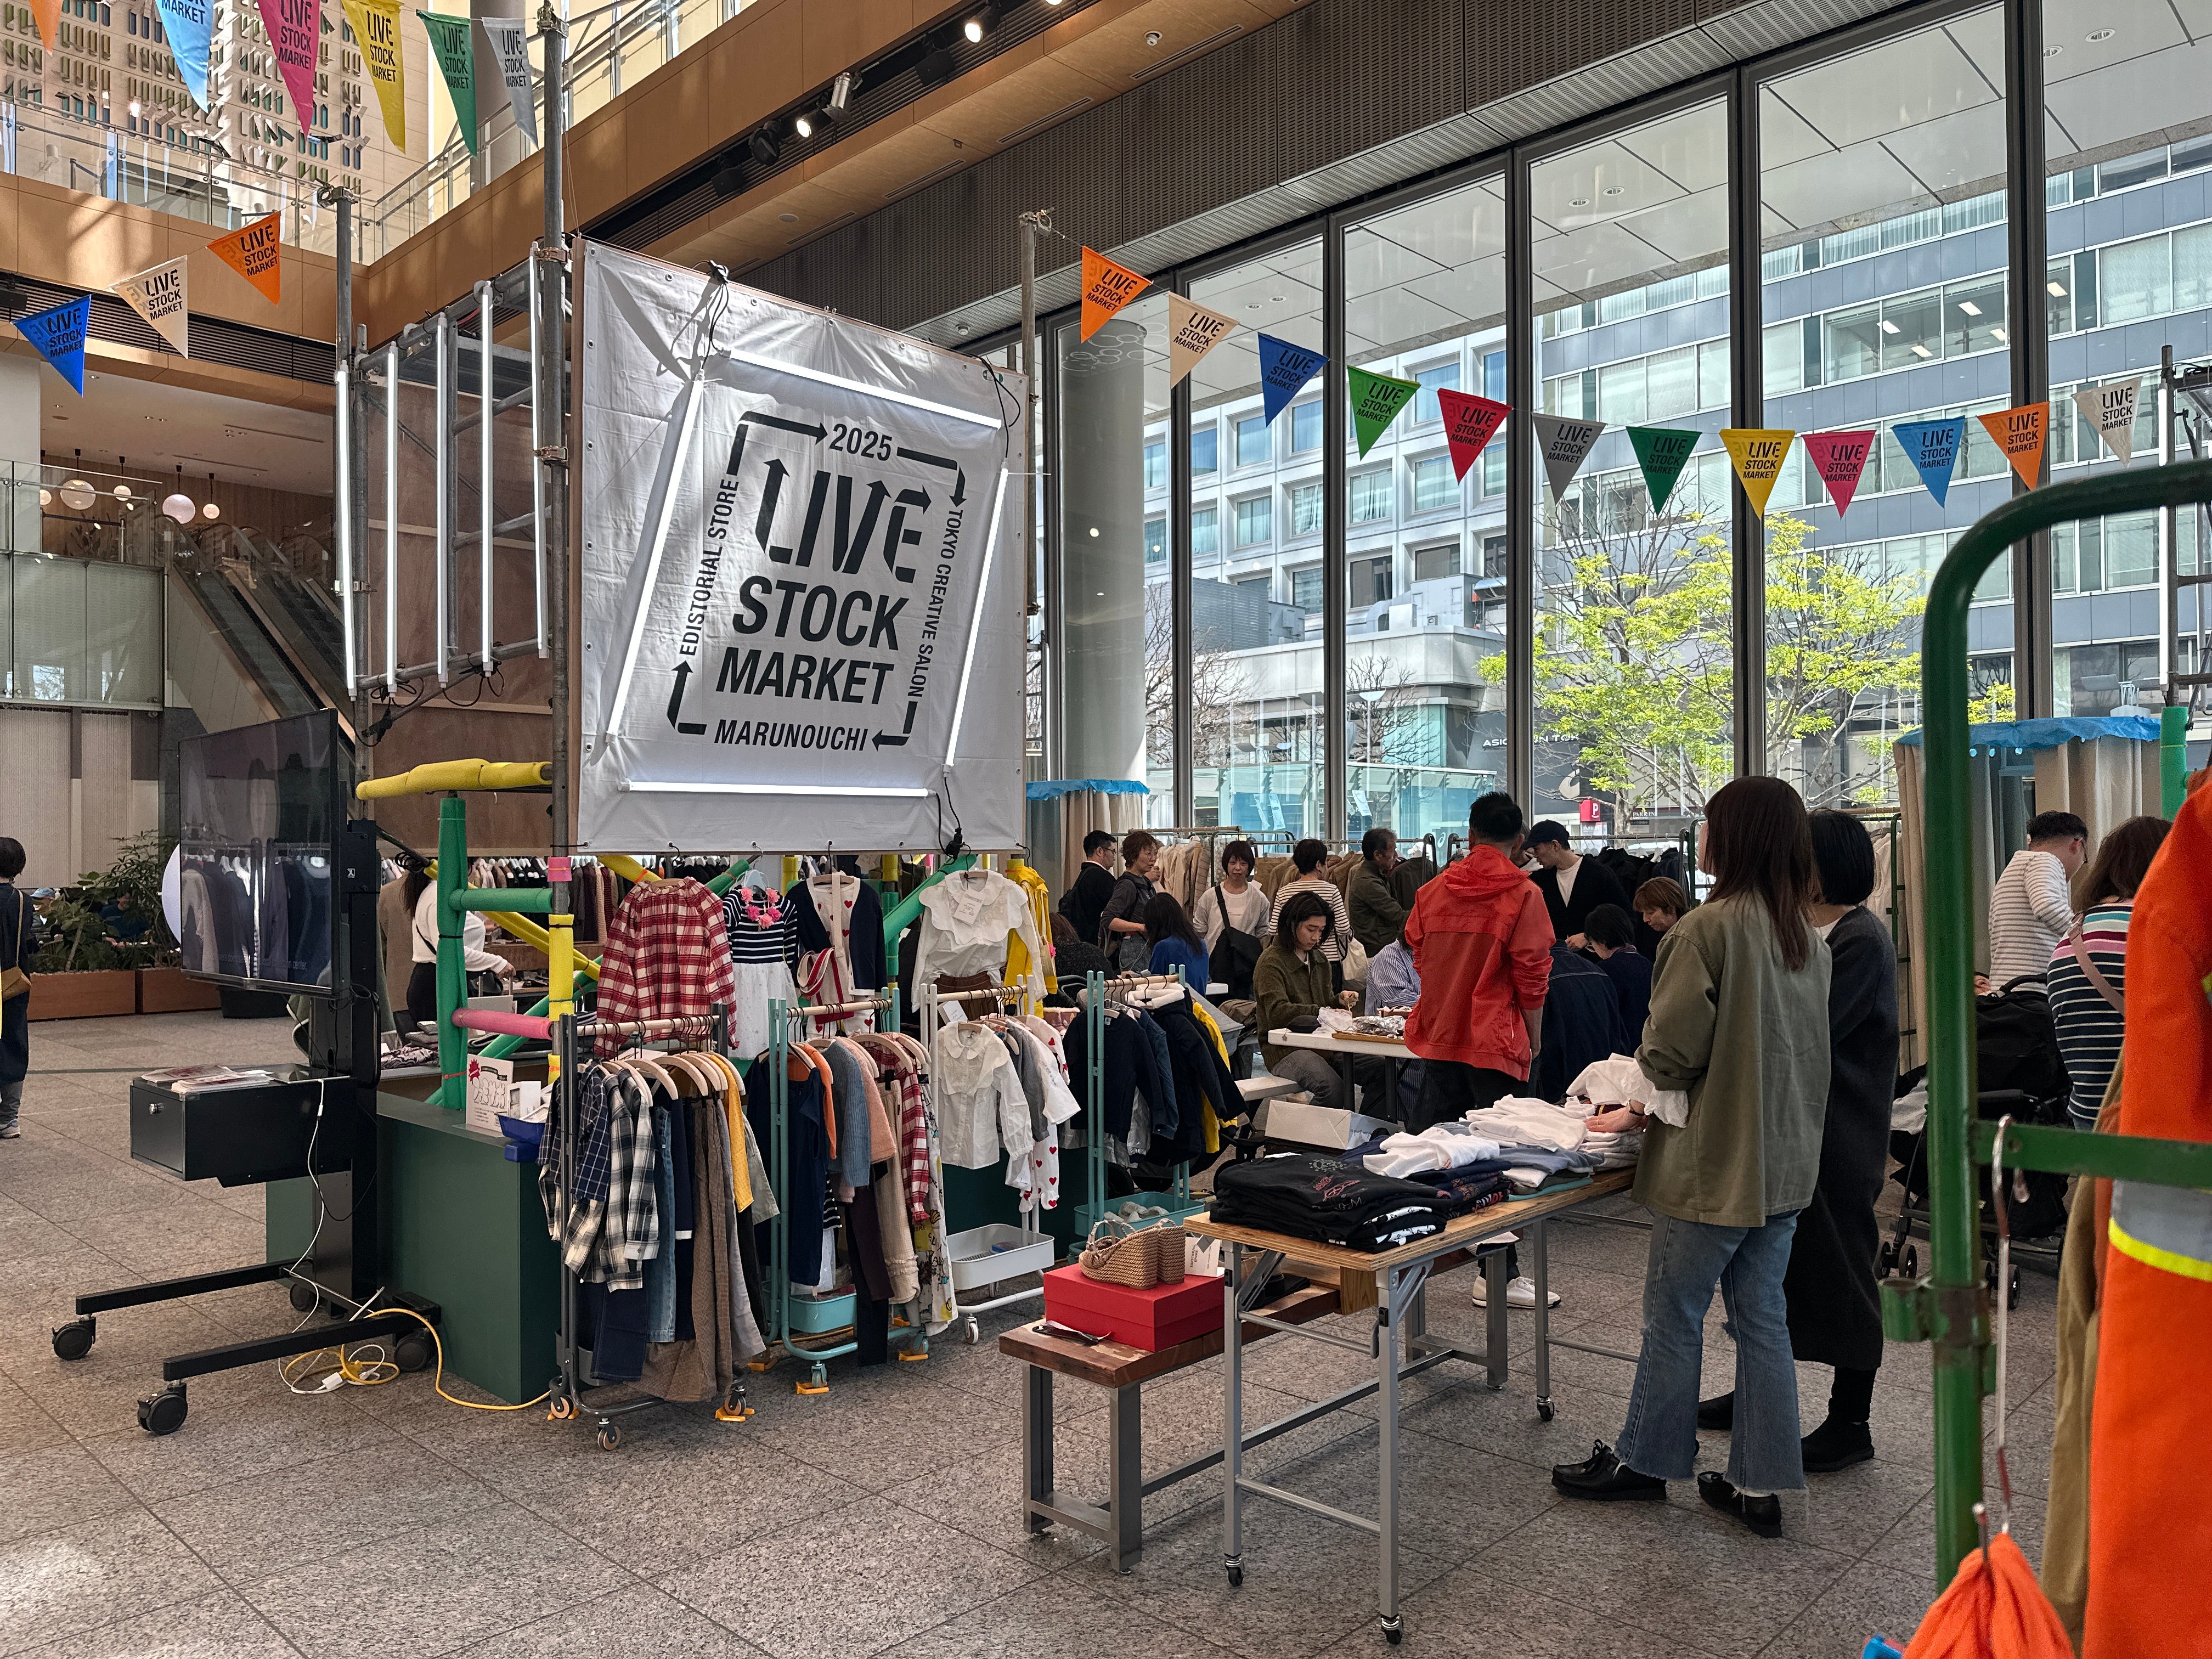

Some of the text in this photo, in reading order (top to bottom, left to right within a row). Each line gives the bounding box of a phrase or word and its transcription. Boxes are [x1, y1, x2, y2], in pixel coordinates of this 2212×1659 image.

[162, 0, 205, 25] MARKET
[281, 0, 312, 32] LIVE
[366, 10, 393, 47] LIVE
[281, 26, 311, 53] STOCK
[442, 25, 466, 55] LIVE
[501, 29, 522, 55] LIVE
[279, 48, 311, 70] MARKET
[370, 45, 396, 66] STOCK
[371, 63, 396, 82] MARKET
[445, 57, 468, 74] STOCK
[505, 58, 524, 73] STOCK
[445, 74, 469, 89] MARKET
[506, 76, 526, 87] MARKET
[240, 224, 274, 252] LIVE
[245, 245, 276, 266] STOCK
[247, 257, 278, 276] MARKET
[145, 269, 179, 296] LIVE
[1102, 269, 1137, 294] LIVE
[149, 290, 181, 310] STOCK
[1086, 294, 1118, 311] MARKET
[1092, 284, 1125, 304] STOCK
[150, 302, 183, 320] MARKET
[47, 308, 81, 335] LIVE
[1189, 312, 1224, 337] LIVE
[49, 331, 82, 348] STOCK
[1173, 336, 1206, 354] MARKET
[1180, 328, 1212, 346] STOCK
[50, 341, 82, 357] MARKET
[1279, 349, 1314, 374] LIVE
[1266, 375, 1297, 391] MARKET
[1271, 365, 1304, 383] STOCK
[1369, 382, 1404, 404] LIVE
[2102, 387, 2132, 409] LIVE
[1356, 408, 1389, 422] MARKET
[1361, 399, 1395, 415] STOCK
[2103, 407, 2132, 421] STOCK
[1461, 406, 1497, 428] LIVE
[2008, 411, 2039, 432] LIVE
[2102, 417, 2132, 431] MARKET
[1451, 432, 1484, 447] MARKET
[1454, 424, 1487, 438] STOCK
[1557, 424, 1592, 444] LIVE
[1922, 428, 1953, 447] LIVE
[2008, 431, 2038, 444] STOCK
[830, 424, 893, 461] 2025
[1551, 442, 1585, 455] STOCK
[1653, 437, 1688, 455] LIVE
[1749, 442, 1781, 458] LIVE
[2008, 442, 2038, 454] MARKET
[1547, 452, 1581, 464] MARKET
[1648, 454, 1681, 466] STOCK
[1831, 444, 1864, 461] LIVE
[1921, 447, 1951, 460] STOCK
[1646, 465, 1678, 475] MARKET
[1745, 460, 1776, 470] STOCK
[1828, 462, 1859, 472] STOCK
[1920, 458, 1951, 469] MARKET
[1825, 473, 1857, 482] MARKET
[755, 458, 932, 583] LIVE
[680, 479, 739, 656] EDISTORIAL STORE
[732, 575, 909, 651] STOCK
[908, 510, 964, 698] TOKYO CREATIVE SALON
[715, 647, 894, 705] MARKET
[714, 719, 868, 751] MARUNOUCHI
[1483, 738, 1508, 747] ASIC
